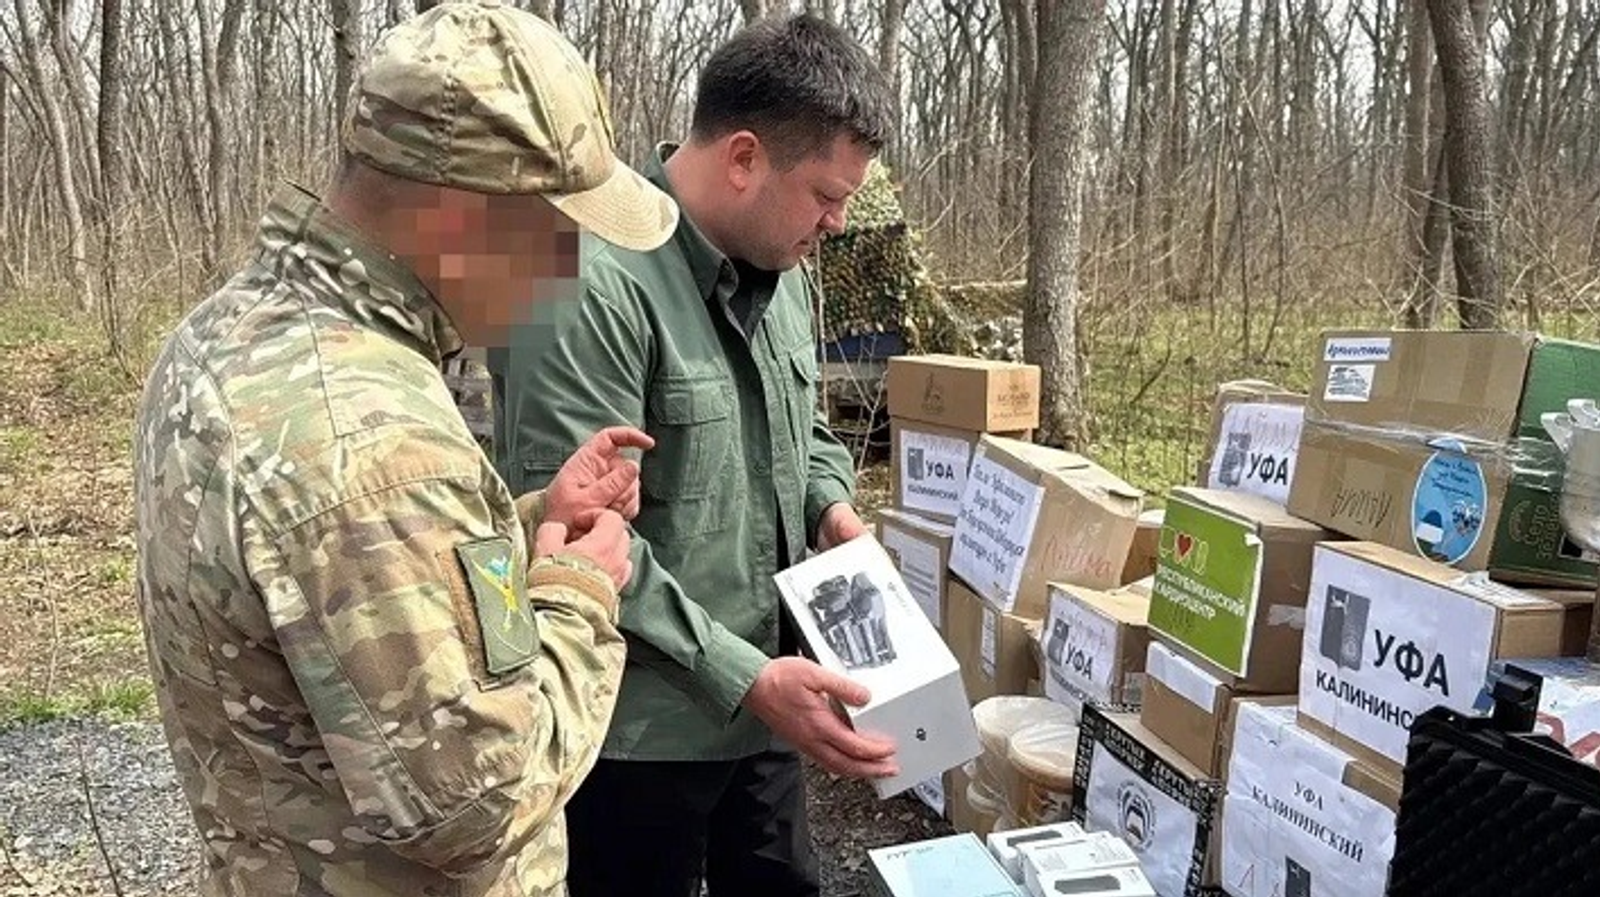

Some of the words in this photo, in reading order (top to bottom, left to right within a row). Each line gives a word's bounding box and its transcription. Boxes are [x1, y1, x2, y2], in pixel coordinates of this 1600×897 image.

[926, 460, 955, 480] УФА
[1247, 452, 1288, 484] УФА
[1066, 643, 1093, 680] УФА
[1373, 629, 1449, 697] УФА
[1316, 669, 1417, 731] КАЛИНИНС
[1294, 781, 1324, 811] УФА
[1252, 786, 1364, 863] КАЛИНИНСКИЙ
